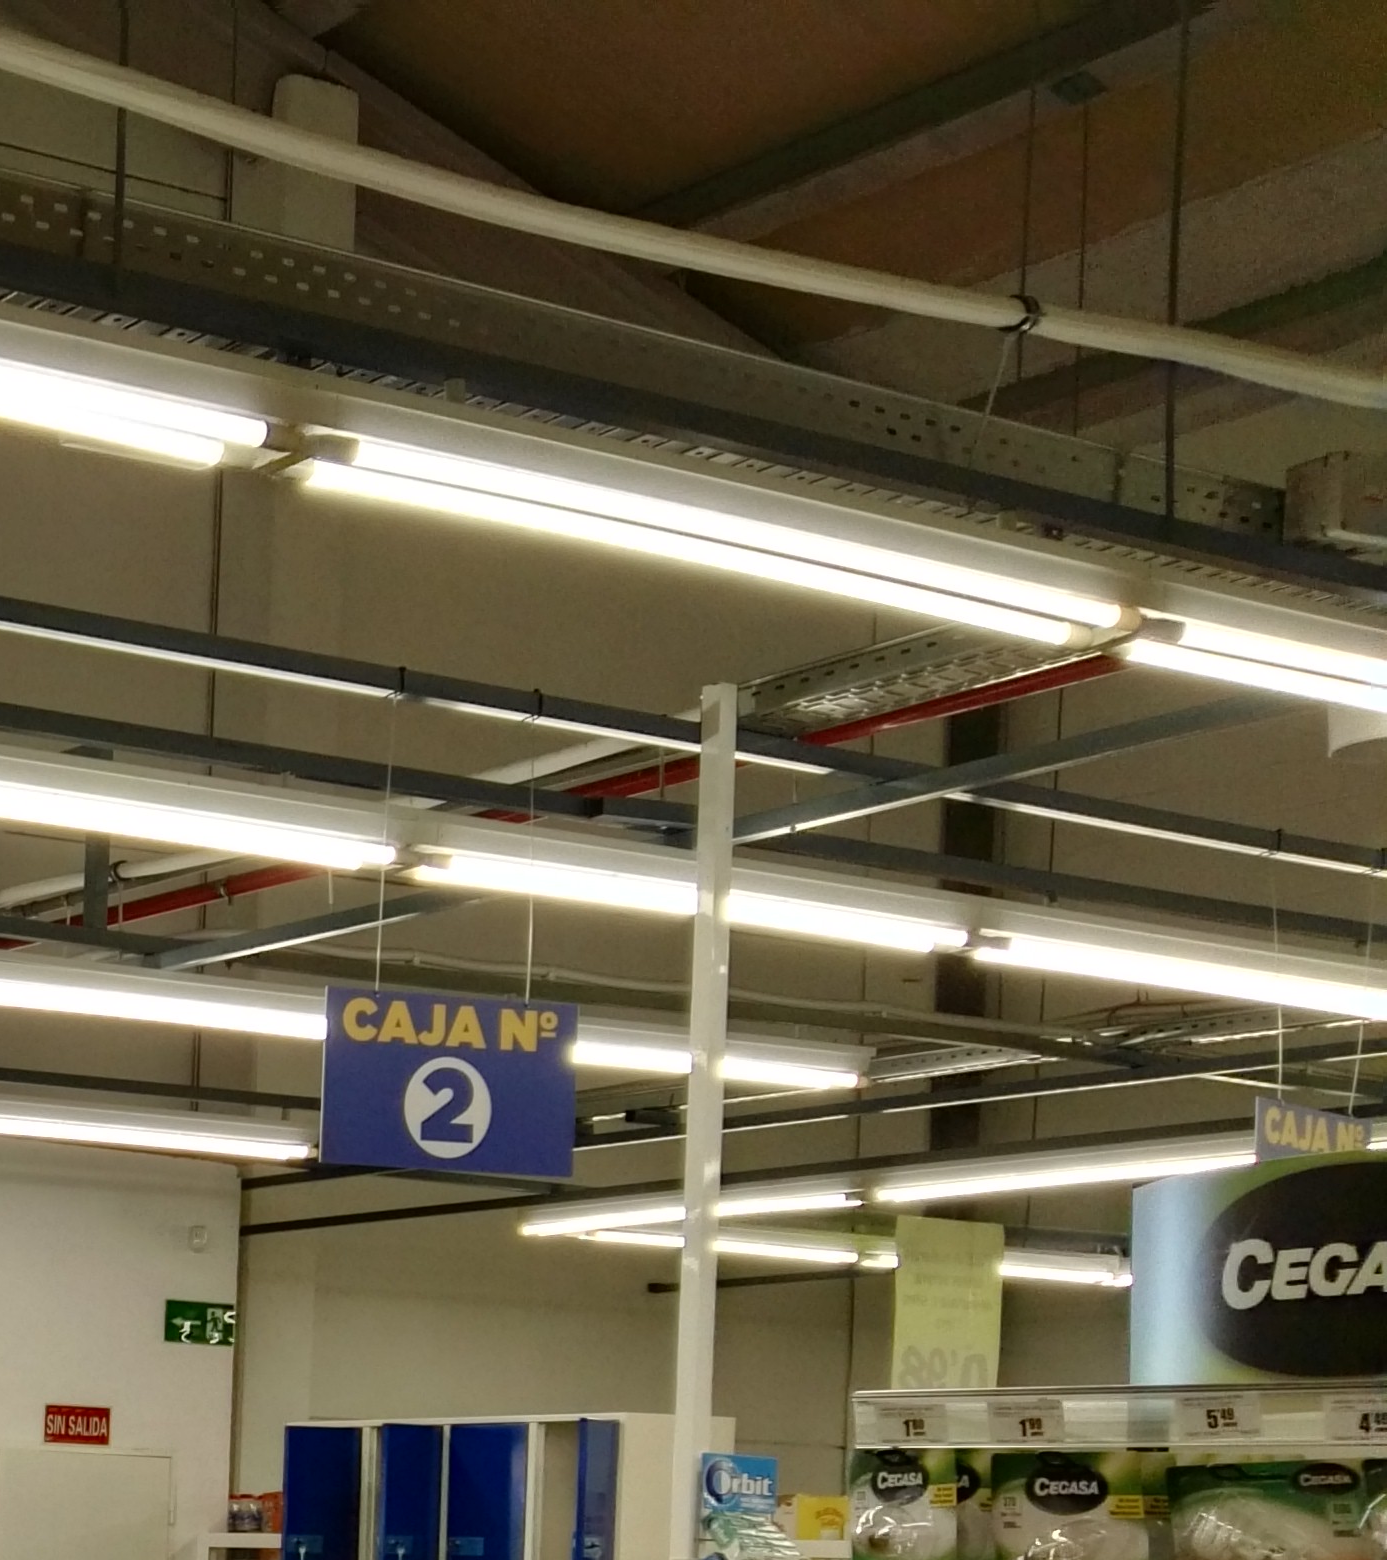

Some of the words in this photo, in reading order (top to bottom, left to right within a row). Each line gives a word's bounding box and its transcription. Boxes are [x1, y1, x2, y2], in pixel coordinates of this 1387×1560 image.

[342, 997, 487, 1051] CAJA
[499, 1008, 559, 1053] Nº
[420, 1067, 475, 1144] 2
[1264, 1105, 1329, 1152] CAJA
[46, 1413, 66, 1435] SIN
[68, 1415, 109, 1437] SALIDA
[718, 1467, 772, 1498] Orbit
[877, 1471, 924, 1489] CEGASA
[1033, 1477, 1100, 1496] CEGASA
[1298, 1473, 1353, 1487] CEGASA
